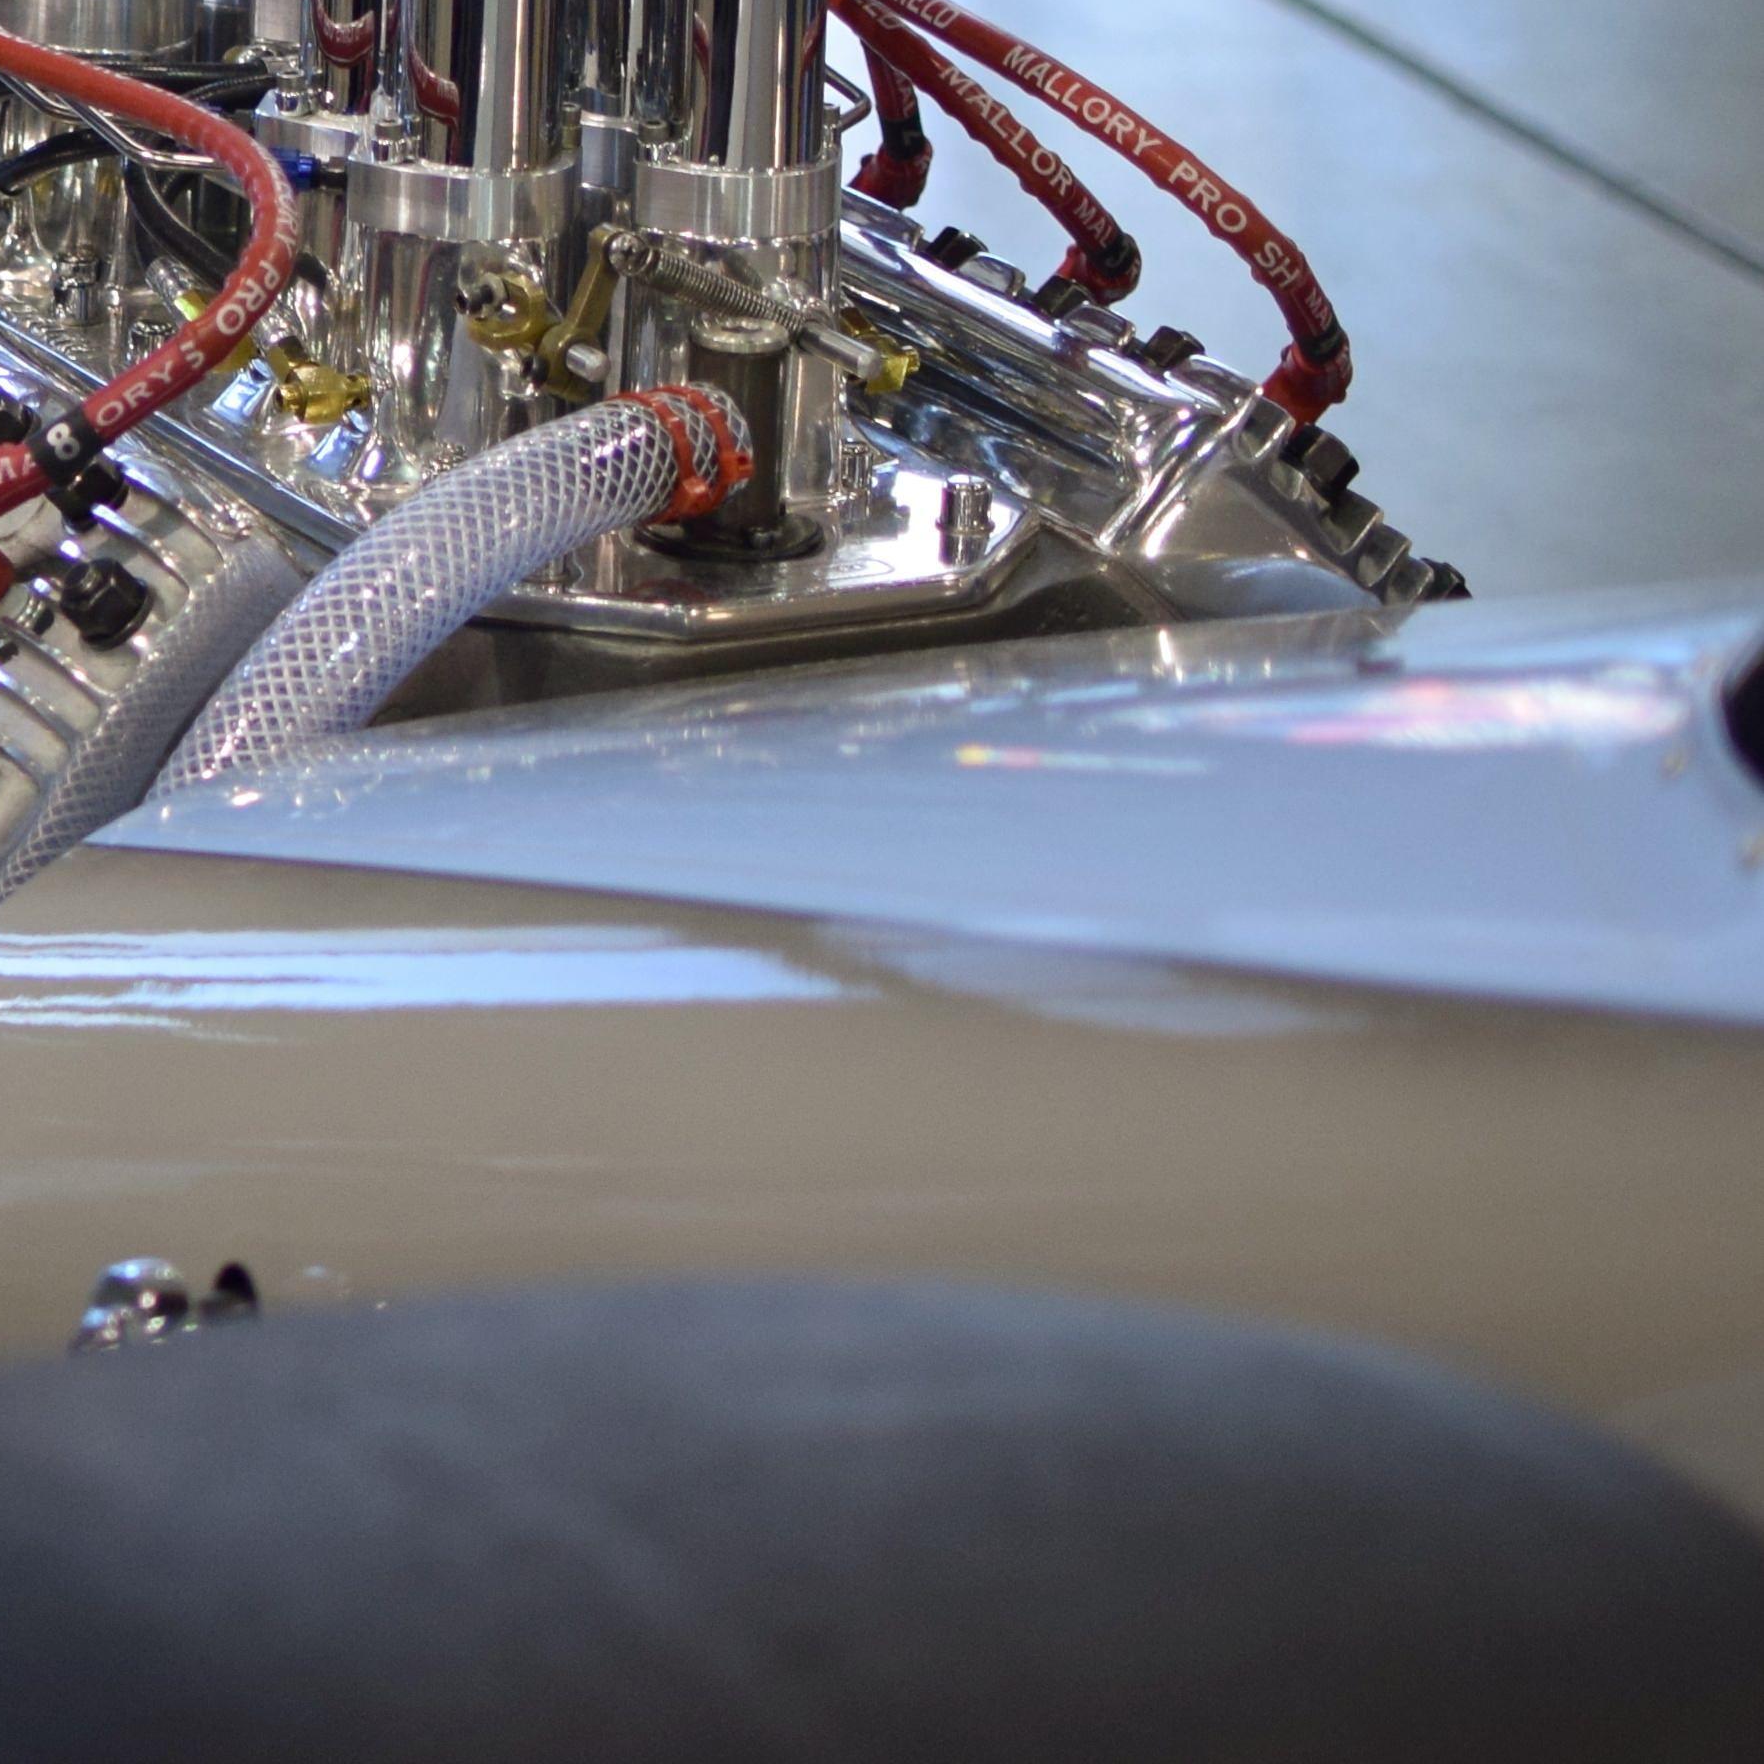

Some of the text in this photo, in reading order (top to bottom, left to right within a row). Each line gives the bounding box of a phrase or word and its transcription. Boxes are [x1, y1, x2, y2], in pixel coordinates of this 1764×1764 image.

[938, 64, 1074, 197] MALLOR
[1002, 42, 1164, 157] MALLORY
[1167, 159, 1249, 234] PRO
[215, 258, 280, 335] PRO
[45, 422, 82, 462] 8
